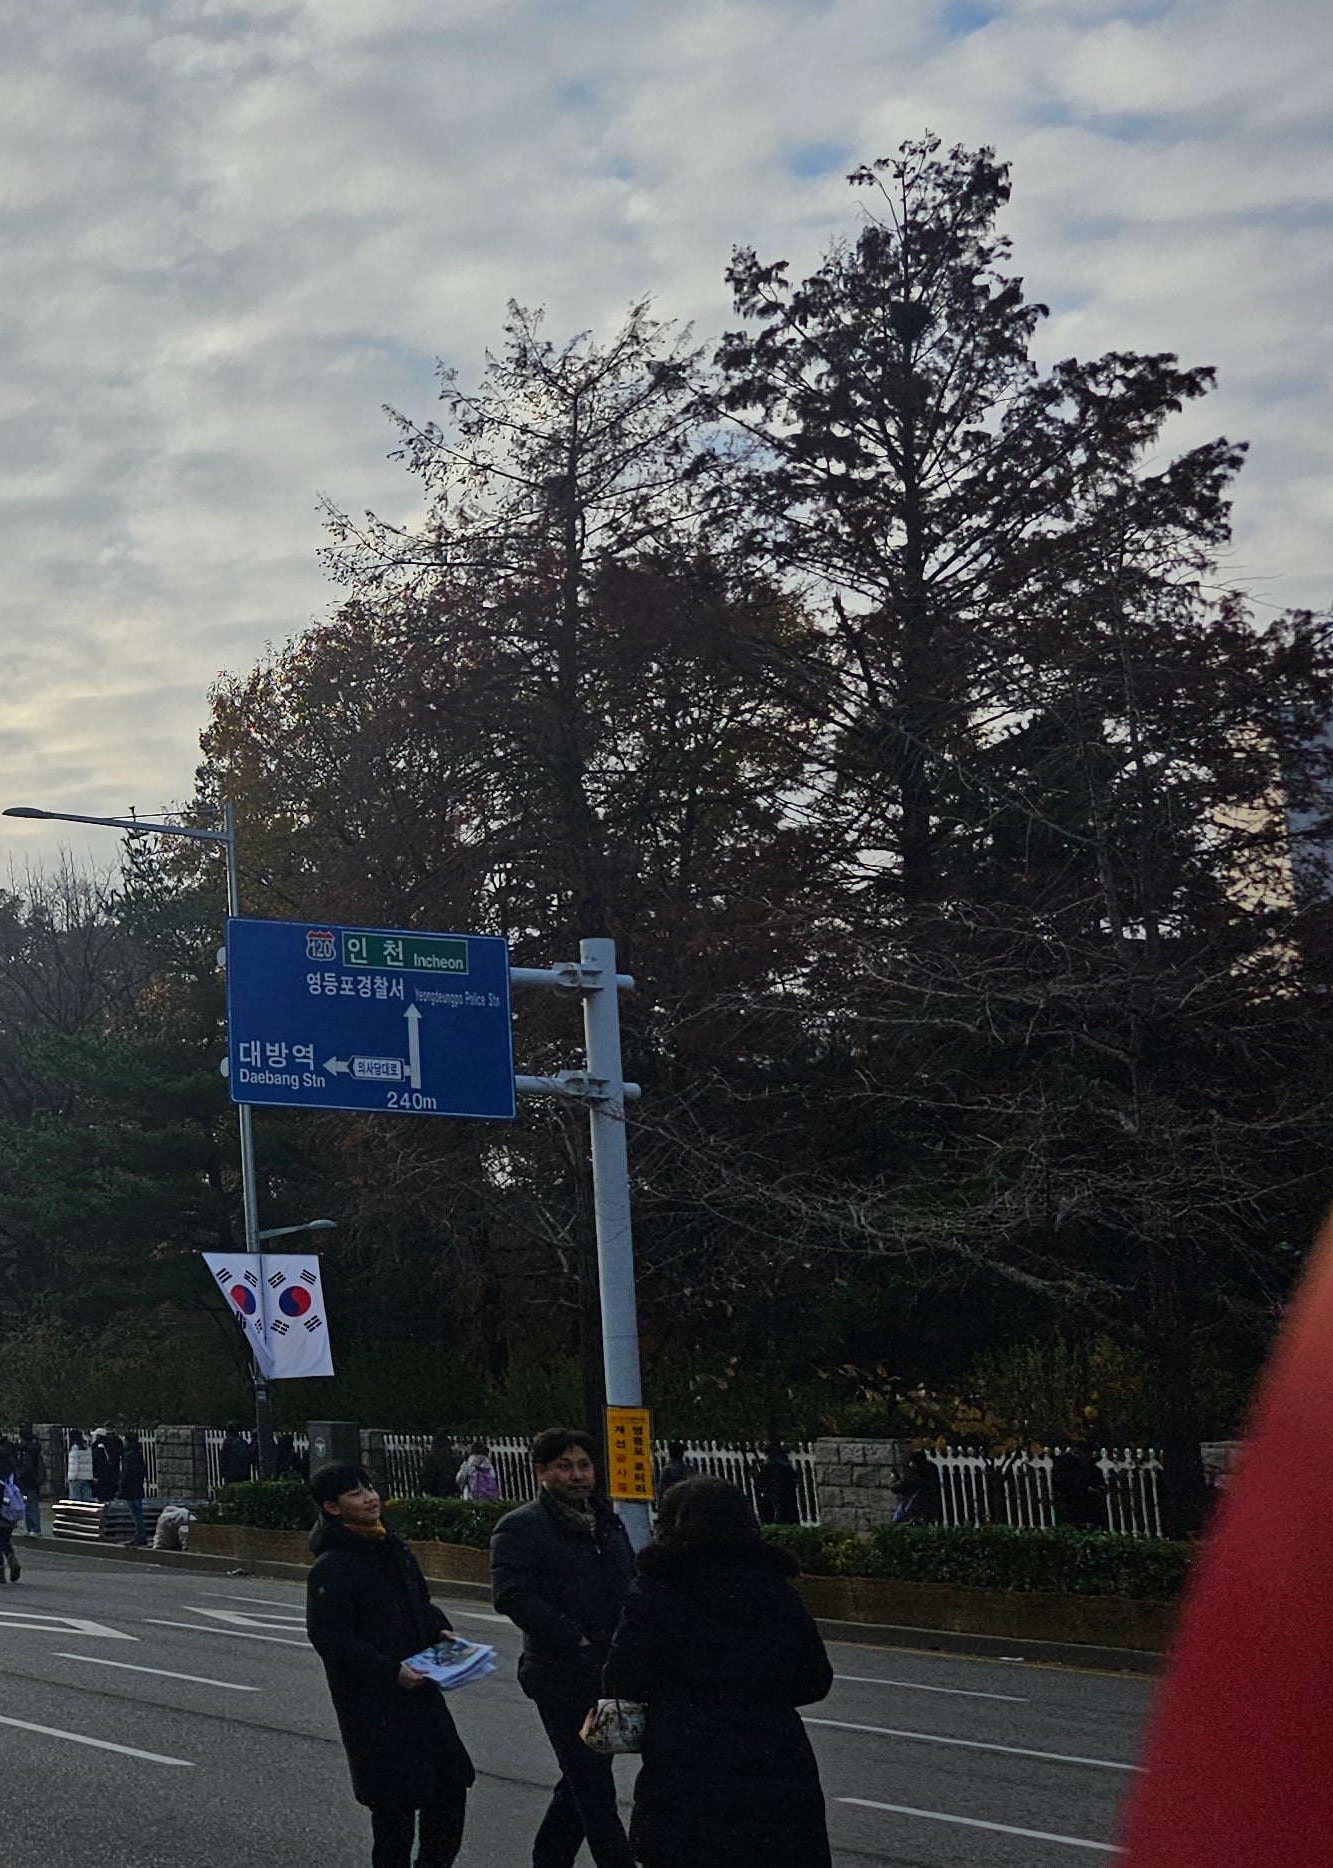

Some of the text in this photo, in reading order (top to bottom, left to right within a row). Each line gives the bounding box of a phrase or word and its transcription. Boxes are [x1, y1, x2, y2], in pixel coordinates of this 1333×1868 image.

[310, 939, 332, 958] 120
[413, 953, 464, 970] Incheon
[306, 971, 405, 1001] 영등포경찰서
[414, 988, 501, 1007] Yeongdeungpo Police Stn
[239, 1040, 315, 1071] 대방역
[357, 1061, 399, 1076] 의사당대로
[239, 1069, 326, 1089] Daebang Stn
[387, 1091, 437, 1110] 240m
